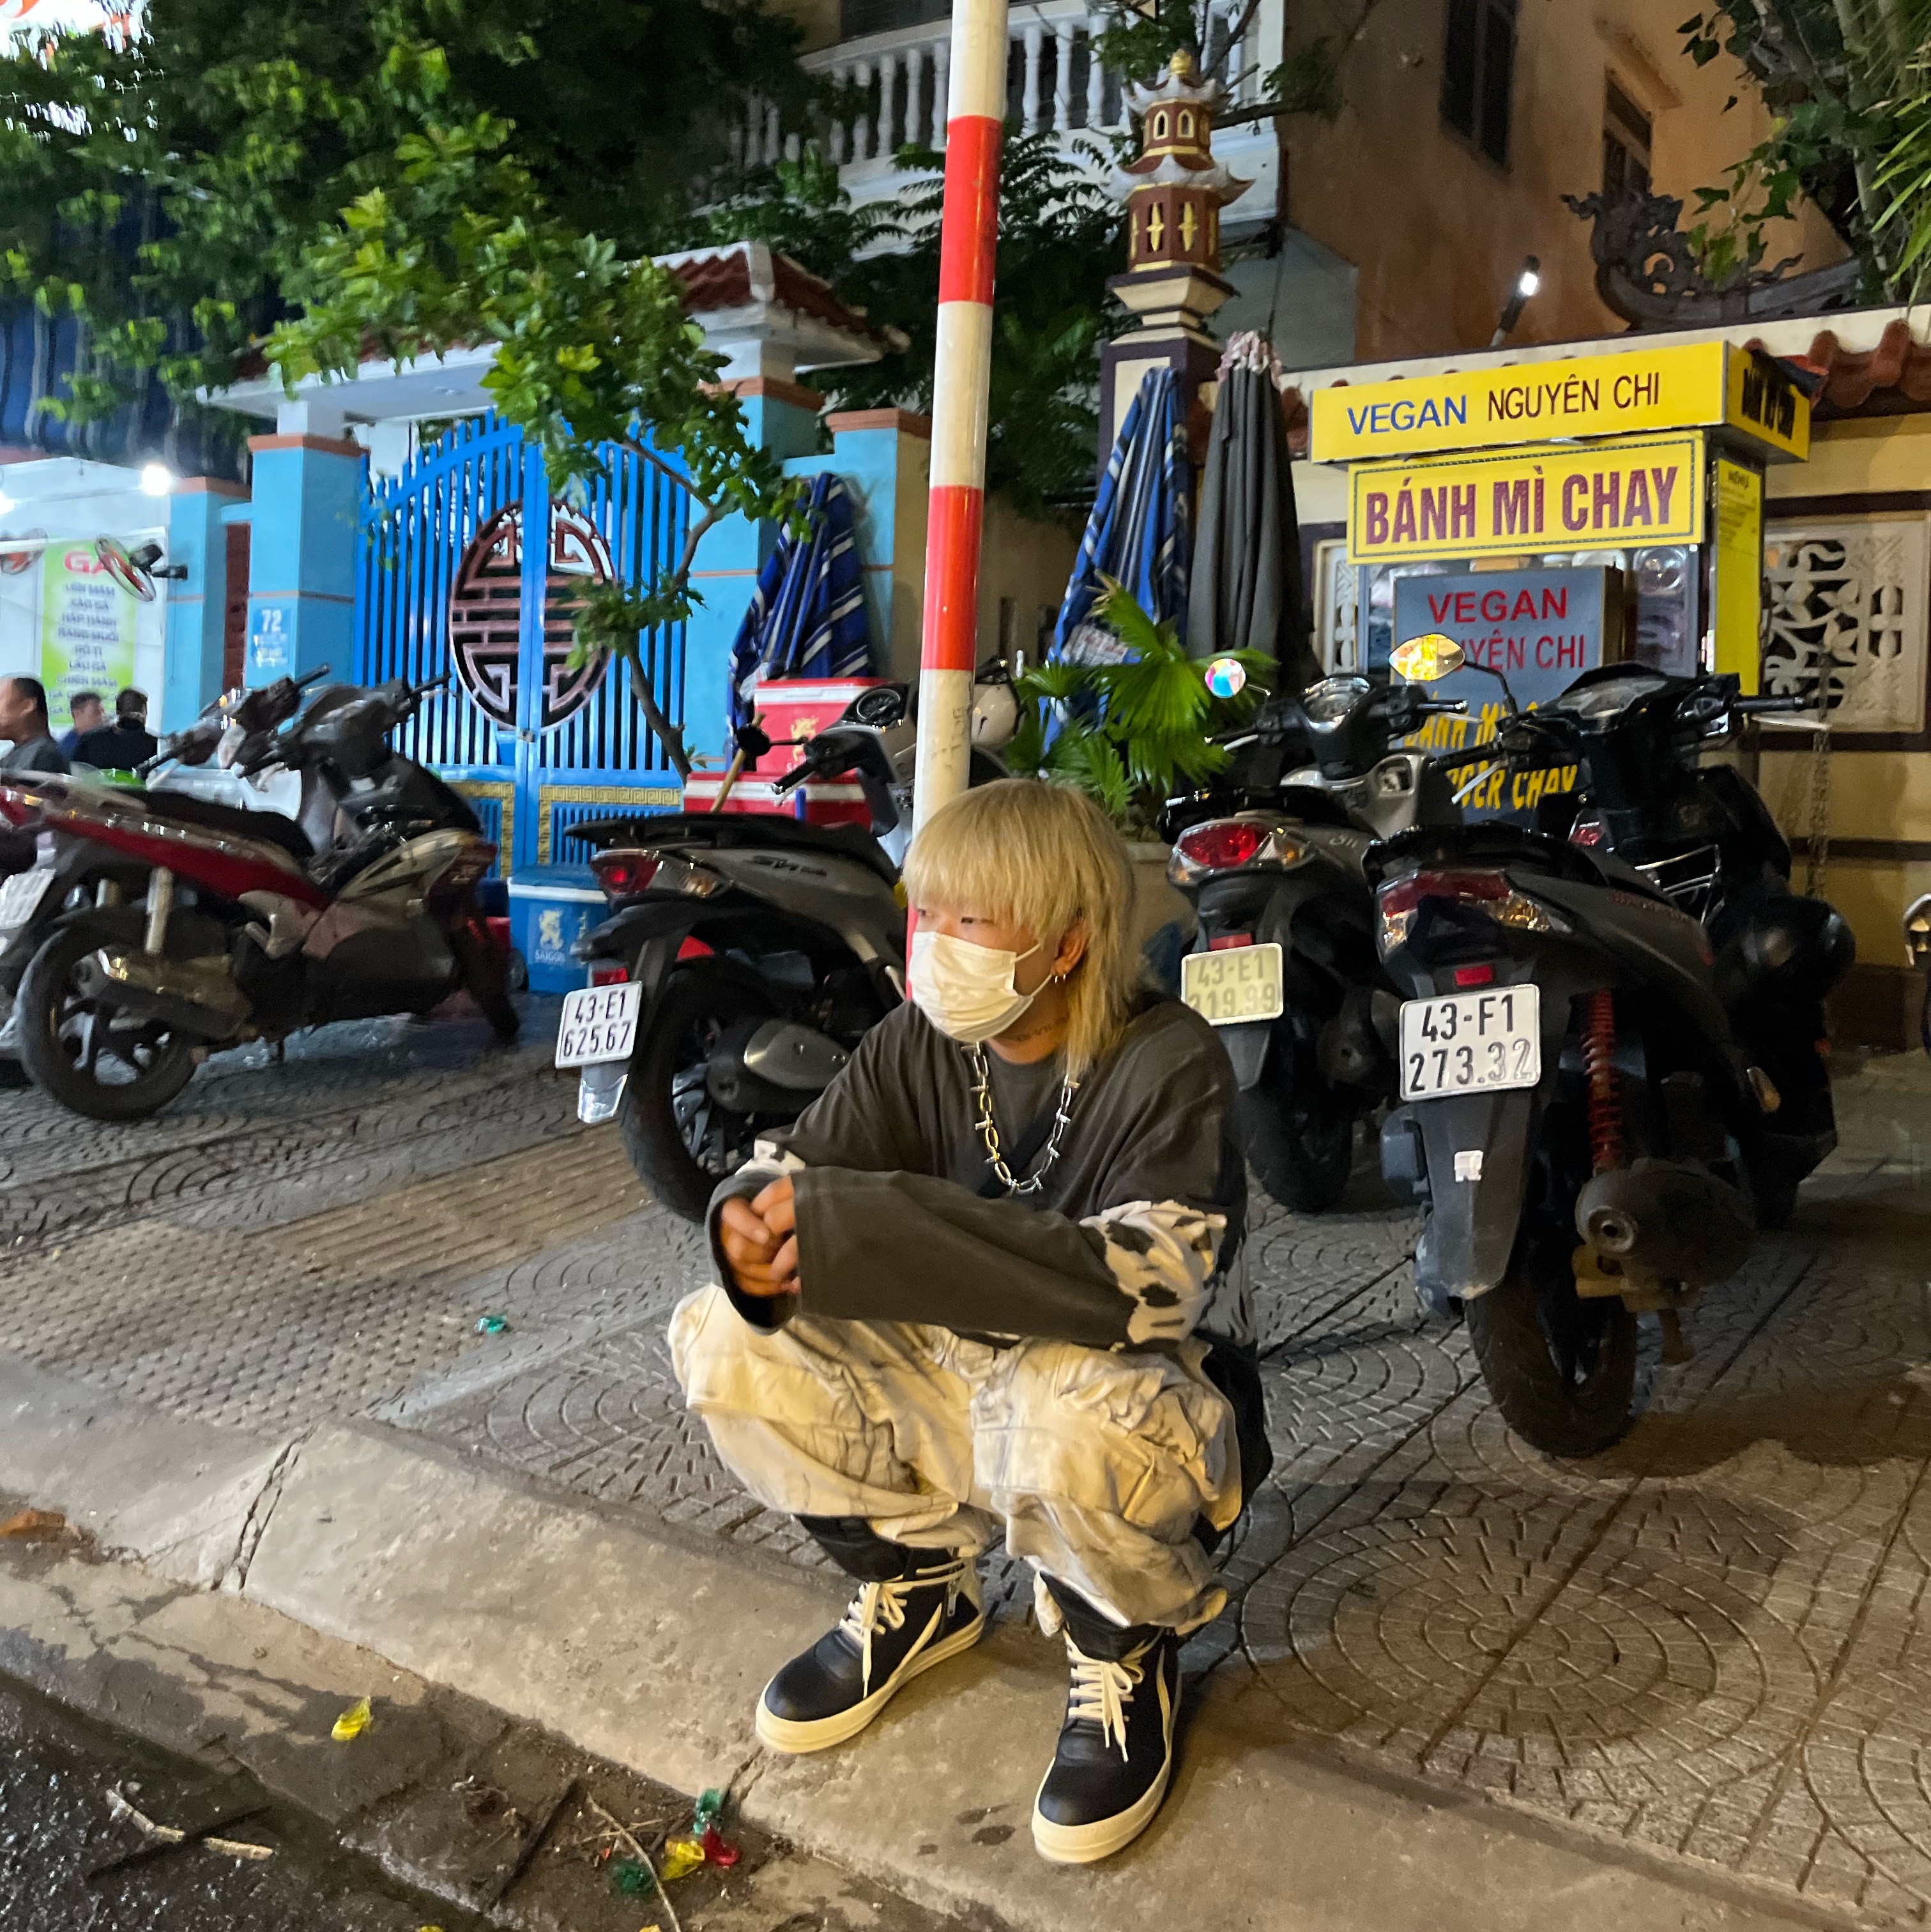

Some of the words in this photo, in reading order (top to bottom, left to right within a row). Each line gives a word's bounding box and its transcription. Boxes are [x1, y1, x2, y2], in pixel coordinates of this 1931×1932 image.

[1347, 394, 1467, 436] VEGAN
[1488, 374, 1599, 422] NGUYÊN
[1613, 371, 1660, 409] CHI
[1366, 476, 1477, 545] BÁNH
[1492, 464, 1545, 536] MÌ
[1562, 466, 1679, 532] CHAY
[261, 609, 282, 632] 72
[1428, 586, 1568, 625] VEGAN
[1454, 628, 1525, 672] YÊN
[1536, 634, 1585, 670] CHI
[1197, 951, 1263, 987] 43-E1
[563, 1020, 632, 1058] 625.67
[1421, 994, 1513, 1042] 43-F1
[1409, 1038, 1532, 1093] 273.32
